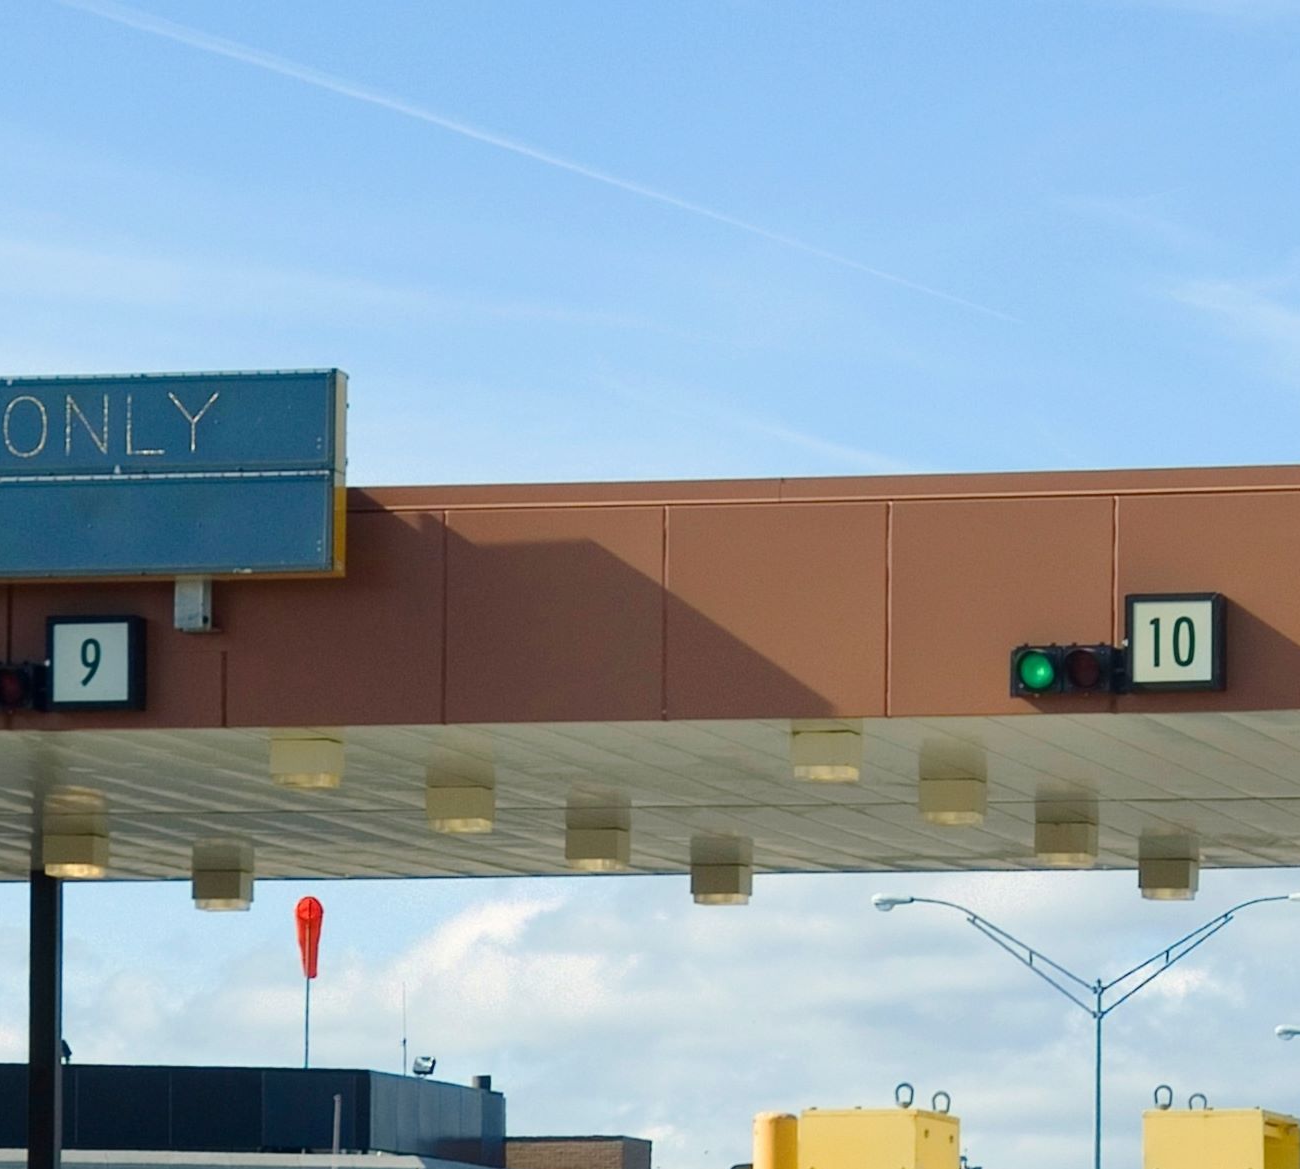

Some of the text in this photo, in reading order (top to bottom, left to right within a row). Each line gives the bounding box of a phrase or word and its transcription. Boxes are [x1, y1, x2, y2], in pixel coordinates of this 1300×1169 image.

[3, 391, 220, 457] ONLY
[79, 638, 101, 687] 9
[1149, 615, 1196, 668] 10
